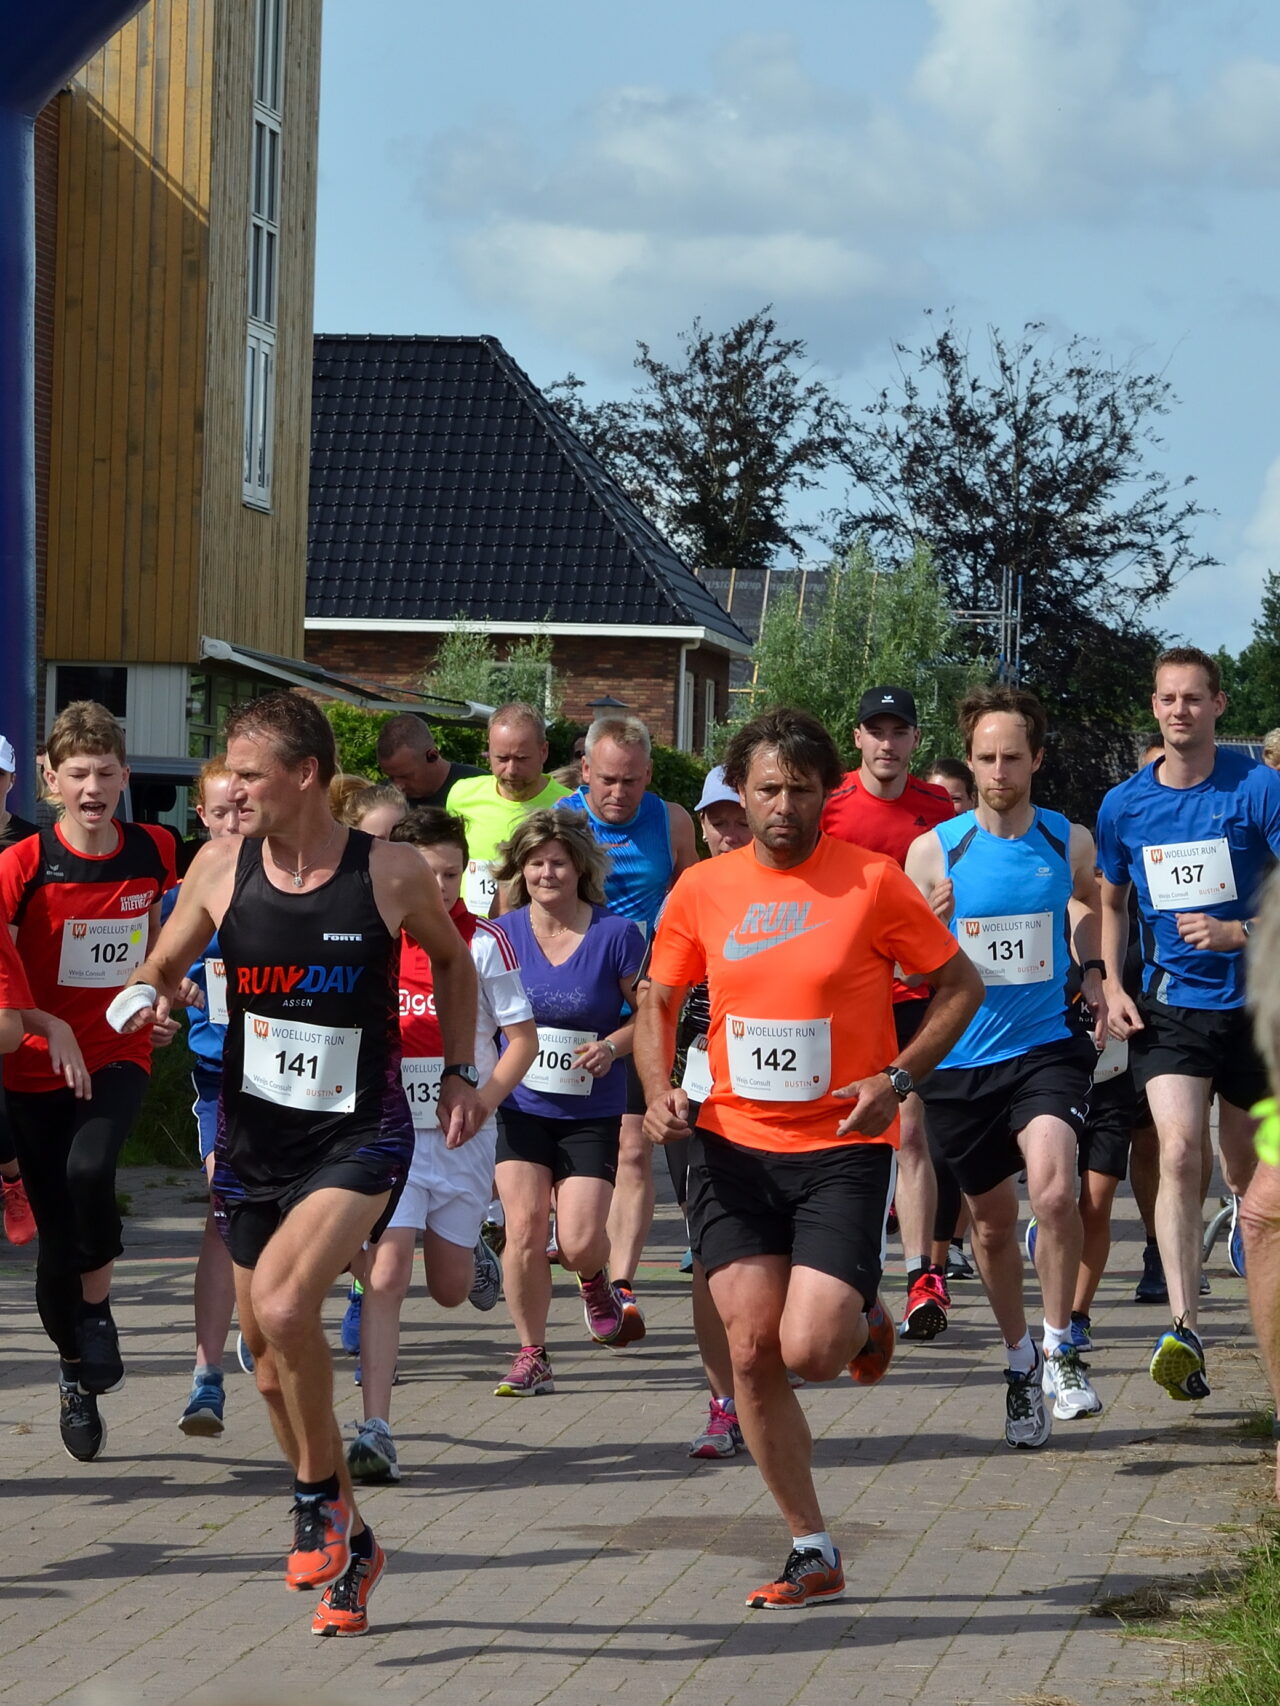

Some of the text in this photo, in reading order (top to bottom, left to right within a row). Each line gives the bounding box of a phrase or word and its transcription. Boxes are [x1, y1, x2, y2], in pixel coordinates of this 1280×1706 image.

[1164, 848, 1200, 859] WOELLUST
[1201, 846, 1217, 855] RUN
[1171, 864, 1204, 885] 137
[739, 901, 813, 935] RUN
[89, 926, 129, 935] WOELLUST
[130, 923, 143, 932] RUN
[982, 922, 1023, 933] WOELLUST
[1025, 920, 1042, 929] RUN
[90, 943, 129, 963] 102
[987, 939, 1024, 960] 131
[282, 998, 313, 1008] ASSEN
[271, 1027, 322, 1044] WOELLUST
[324, 1035, 345, 1046] RUN
[747, 1025, 793, 1037] WOELLUST
[795, 1027, 816, 1037] RUN
[275, 1050, 318, 1080] 141
[537, 1050, 573, 1071] 106
[751, 1047, 797, 1072] 142
[402, 1064, 442, 1074] WOELLUST
[269, 1080, 292, 1092] Consult
[749, 1077, 771, 1087] Consult
[784, 1080, 812, 1088] BUSTIN
[306, 1088, 334, 1097] BUSTIN
[407, 1082, 440, 1103] 133
